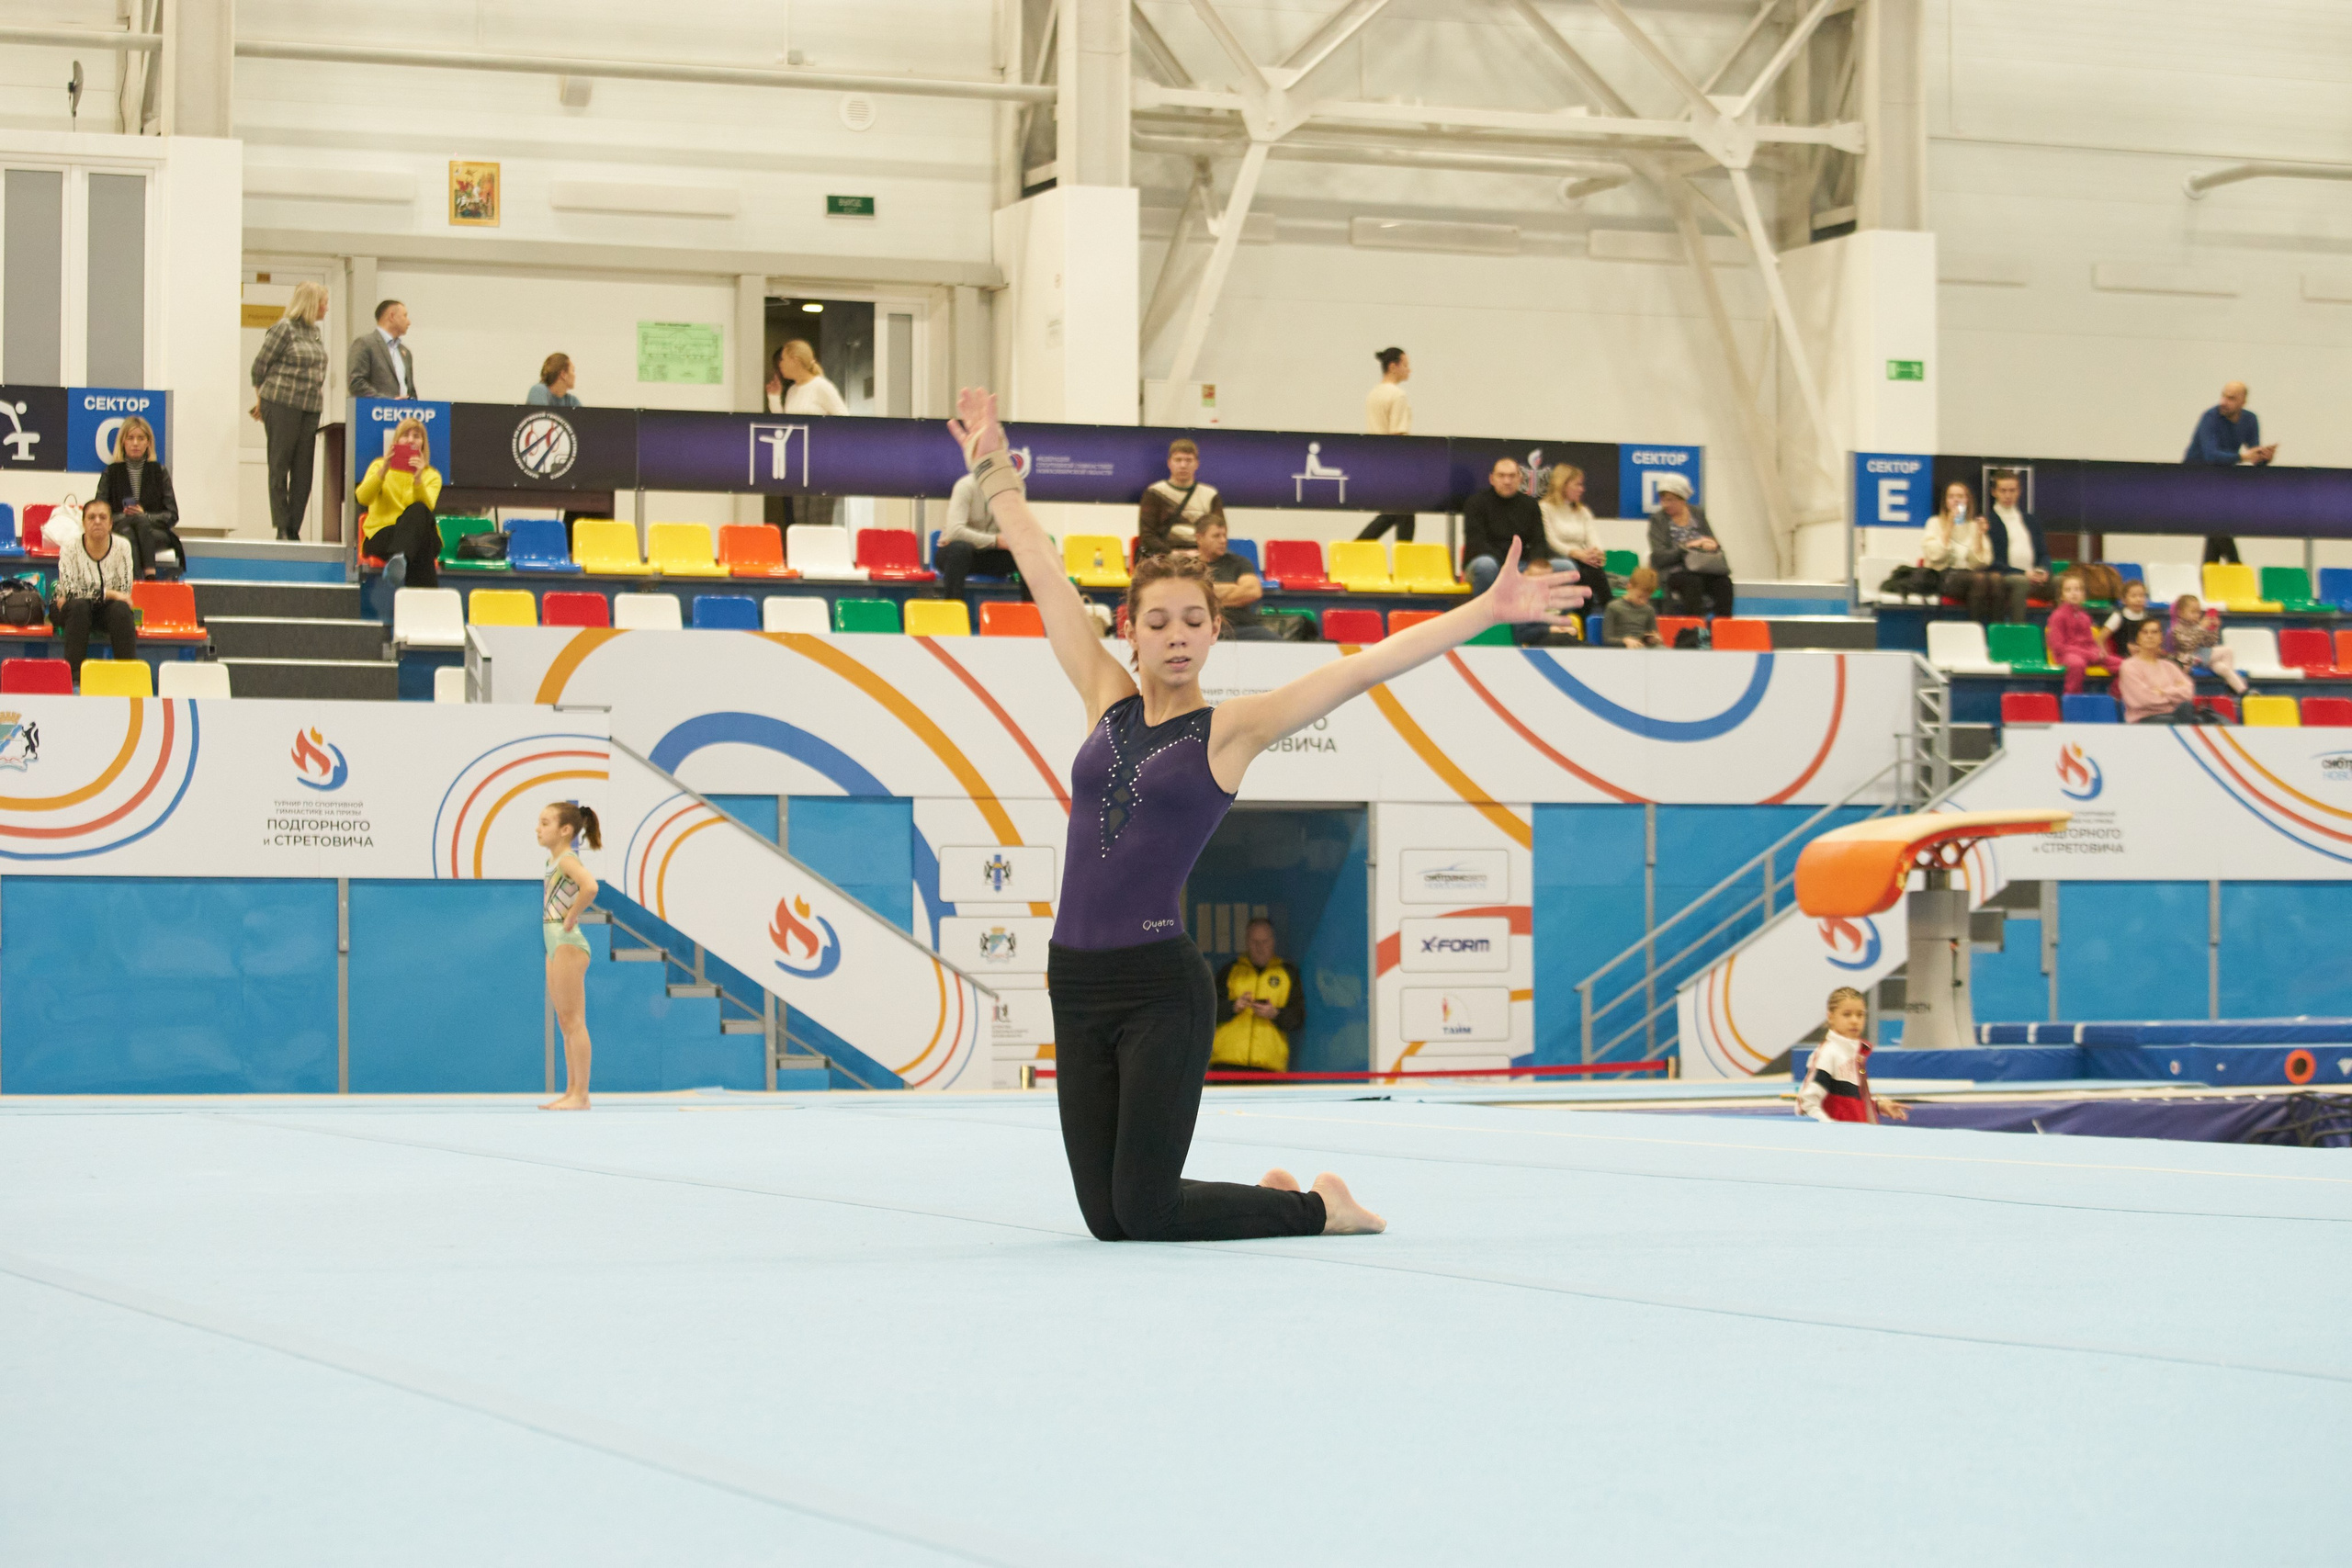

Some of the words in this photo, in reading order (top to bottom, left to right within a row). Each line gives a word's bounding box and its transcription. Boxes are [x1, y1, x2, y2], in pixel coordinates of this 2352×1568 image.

[84, 395, 151, 412] СЕКТОР
[371, 406, 436, 423] СЕКТОР
[1632, 450, 1690, 466] СЕКТОР
[1866, 459, 1922, 474] СЕКТОР
[1878, 479, 1911, 522] E
[267, 818, 370, 832] ПОДГОРНОГО
[263, 838, 270, 846] и
[274, 835, 375, 848] СТРЕТОВИЧА
[2041, 842, 2124, 854] СТРЕТОВИЧА
[1142, 919, 1175, 933] Quatro
[1420, 935, 1491, 953] X-FORM
